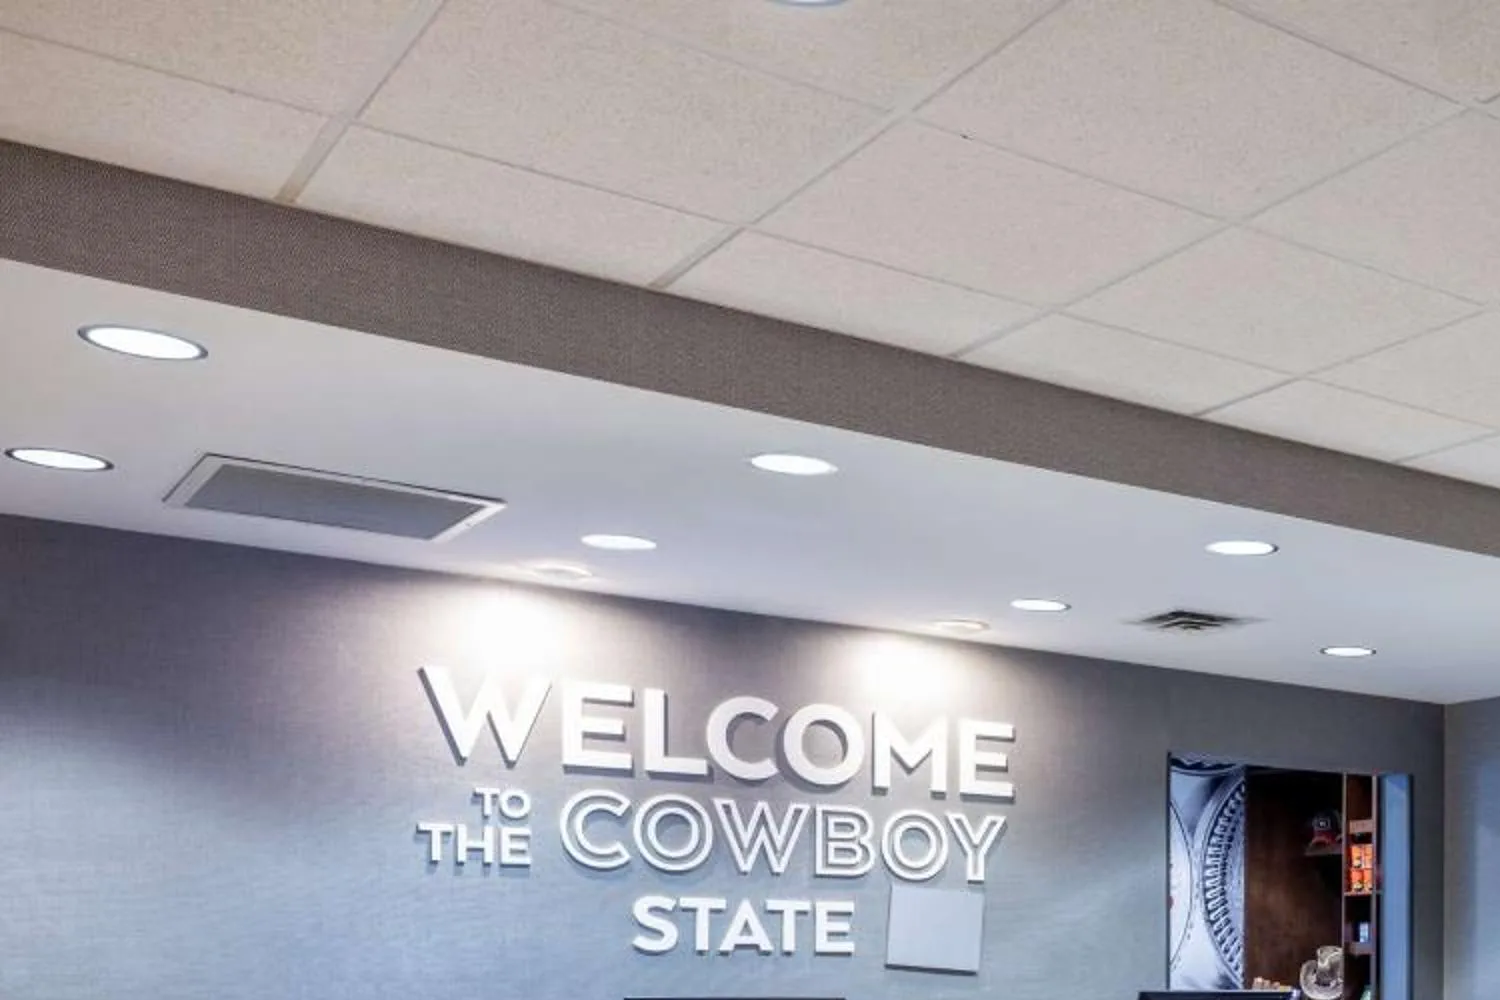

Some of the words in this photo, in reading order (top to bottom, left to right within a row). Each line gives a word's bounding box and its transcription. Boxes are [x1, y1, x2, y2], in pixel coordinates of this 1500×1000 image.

[417, 665, 1014, 803] WELCOME
[416, 822, 532, 867] THE
[559, 788, 1007, 884] COWBOY
[473, 785, 532, 820] TO
[631, 896, 855, 956] STATE
